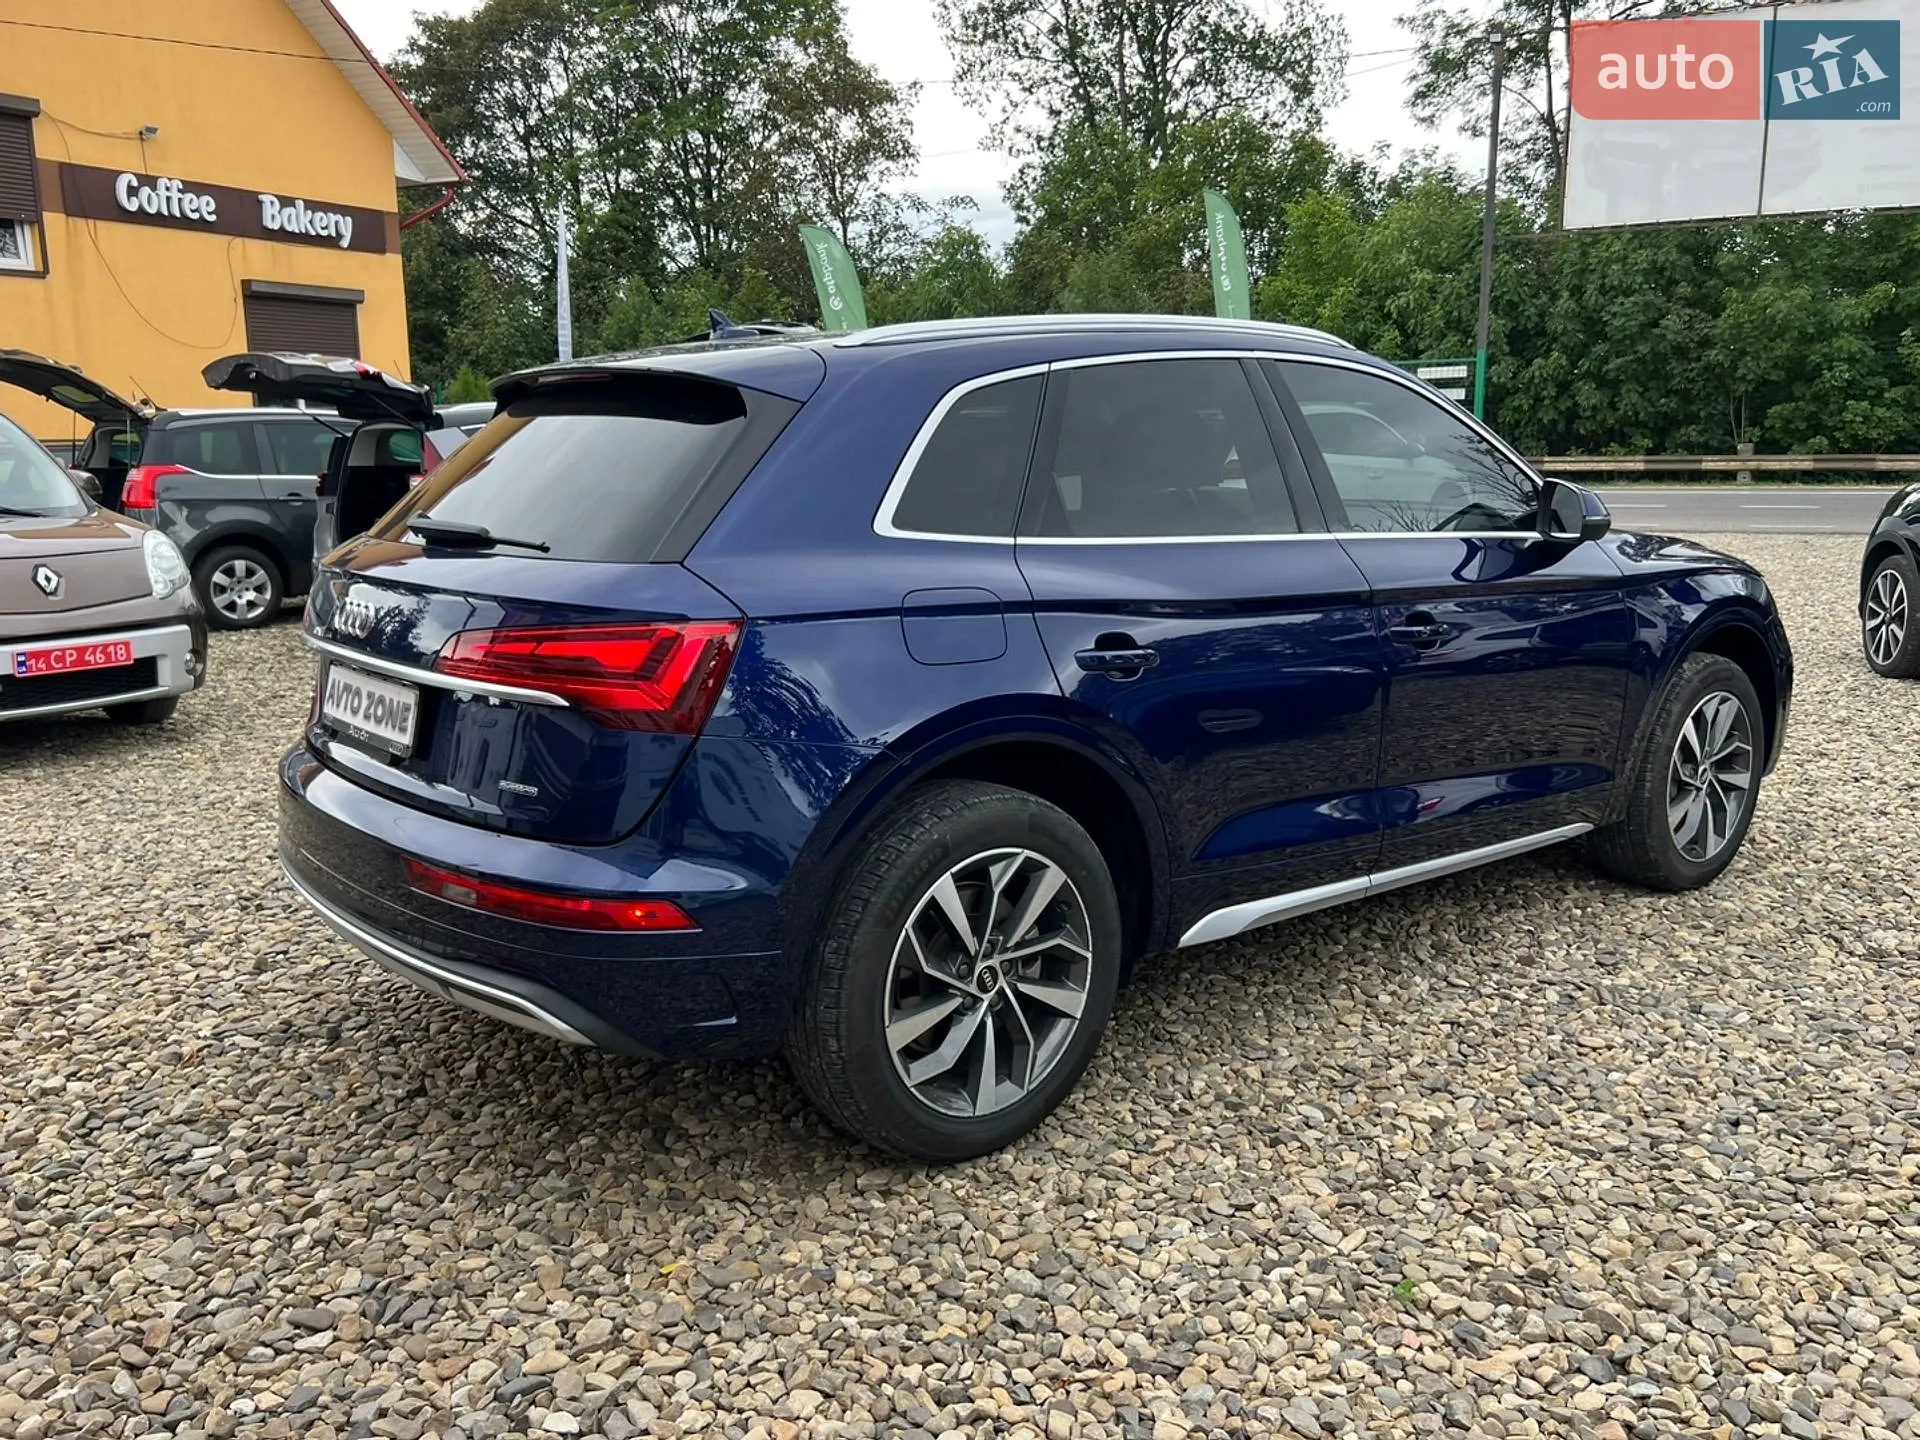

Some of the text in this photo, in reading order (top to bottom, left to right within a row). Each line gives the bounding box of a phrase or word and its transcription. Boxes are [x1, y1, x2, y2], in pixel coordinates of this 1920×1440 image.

[115, 172, 353, 248] Coffee Bakery
[27, 643, 127, 672] 14 CP 4618
[326, 678, 412, 734] AVTO ZONE
